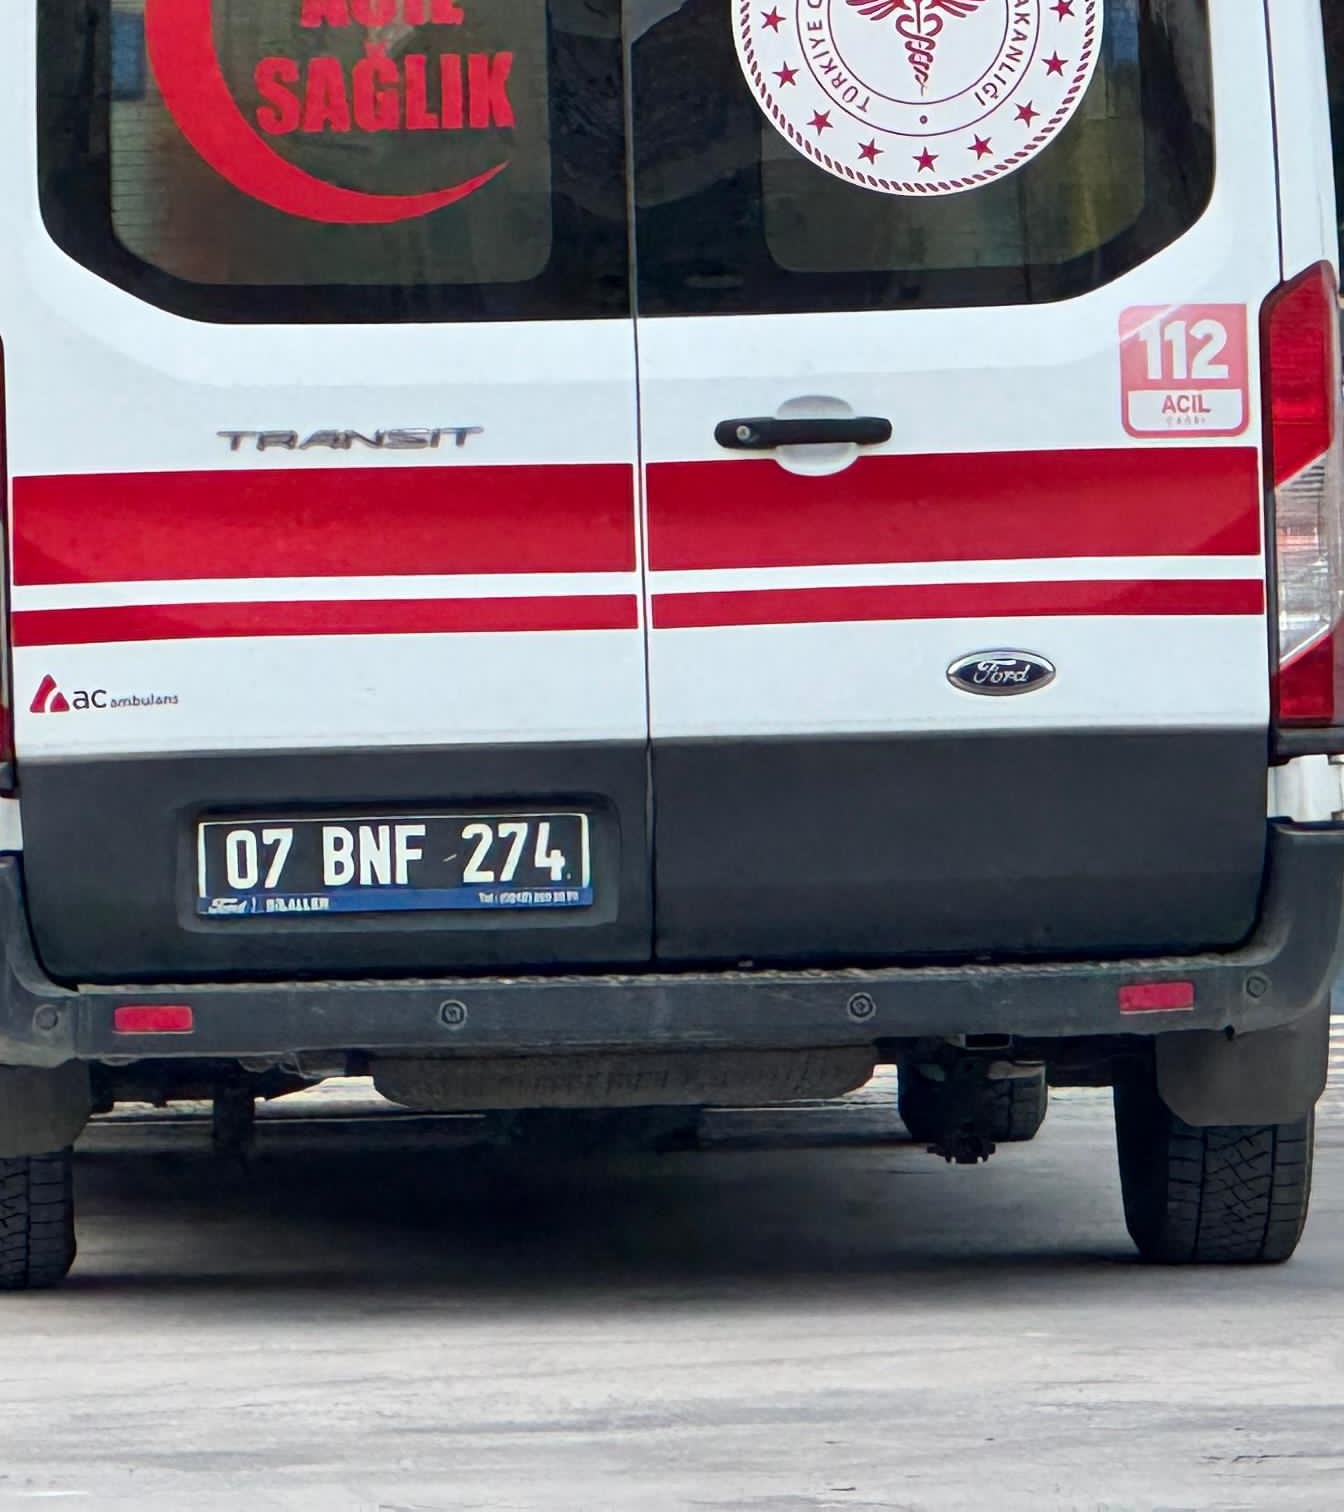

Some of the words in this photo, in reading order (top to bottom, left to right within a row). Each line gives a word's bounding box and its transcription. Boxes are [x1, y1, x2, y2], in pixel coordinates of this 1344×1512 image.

[255, 41, 515, 136] SAĞLIK
[806, 19, 871, 113] TÜRKİYE
[1137, 319, 1230, 380] 112
[216, 425, 485, 452] TRANSIT
[110, 693, 179, 709] ambulans
[225, 828, 294, 889] 07
[321, 824, 428, 887] BNF
[460, 822, 567, 884] 274
